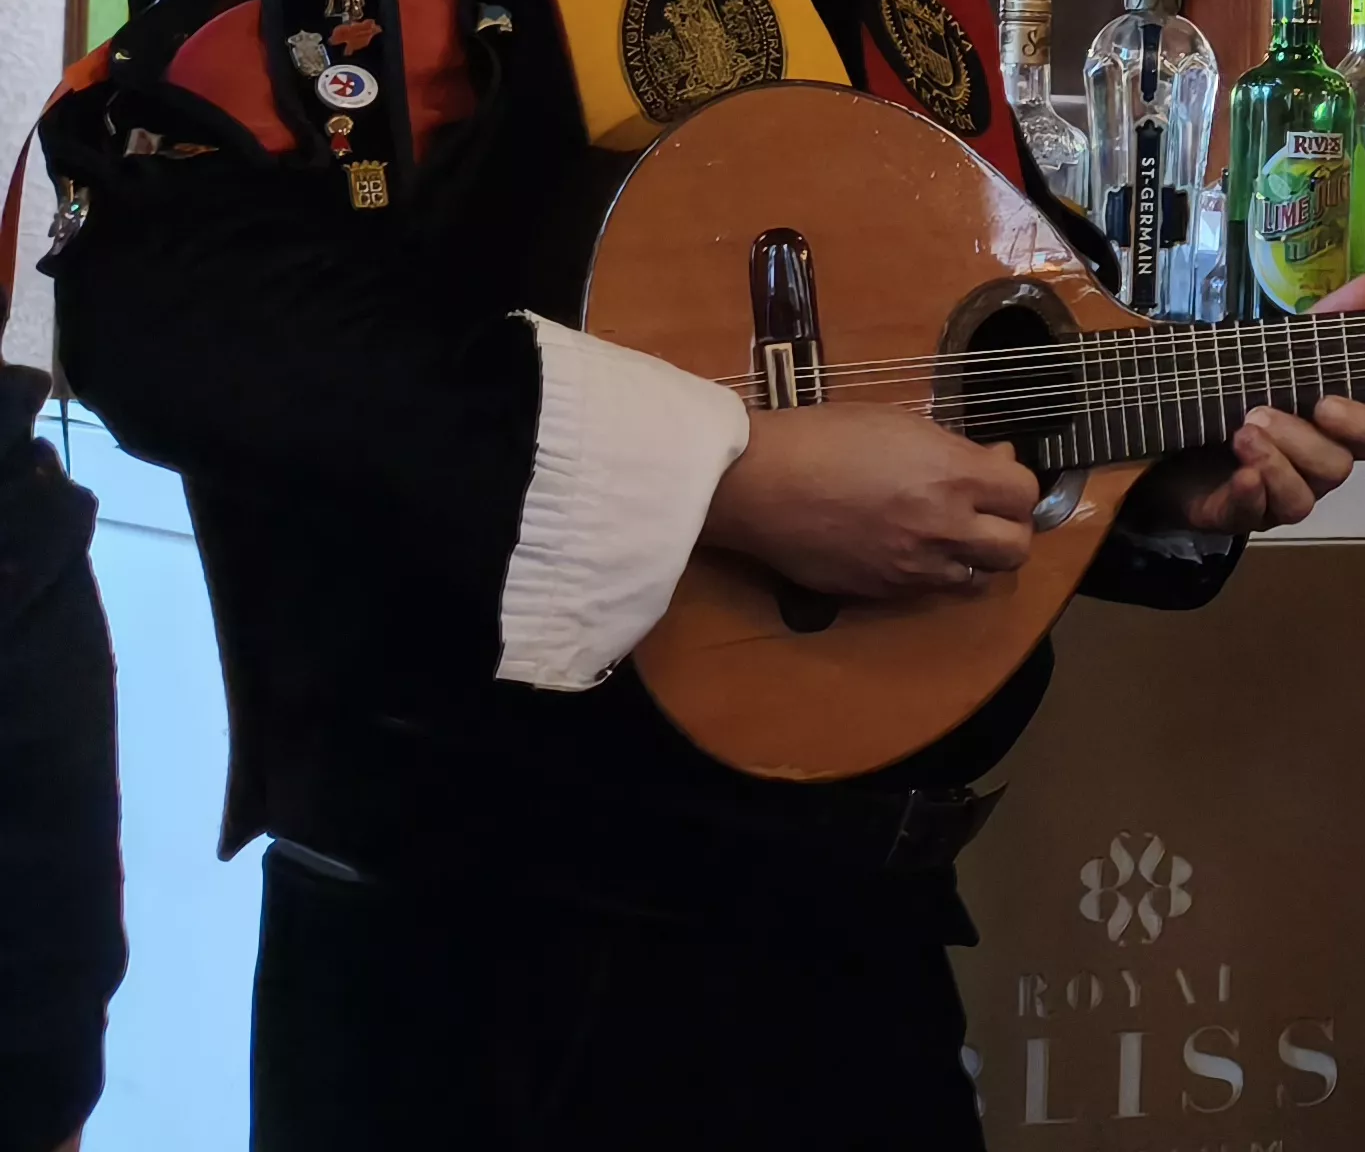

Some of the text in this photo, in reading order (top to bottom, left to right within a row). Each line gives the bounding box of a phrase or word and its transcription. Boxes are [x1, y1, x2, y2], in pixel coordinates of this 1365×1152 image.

[1293, 135, 1342, 156] RIVES
[1137, 156, 1156, 276] ST-GERMAIN
[1262, 195, 1312, 235] LIME
